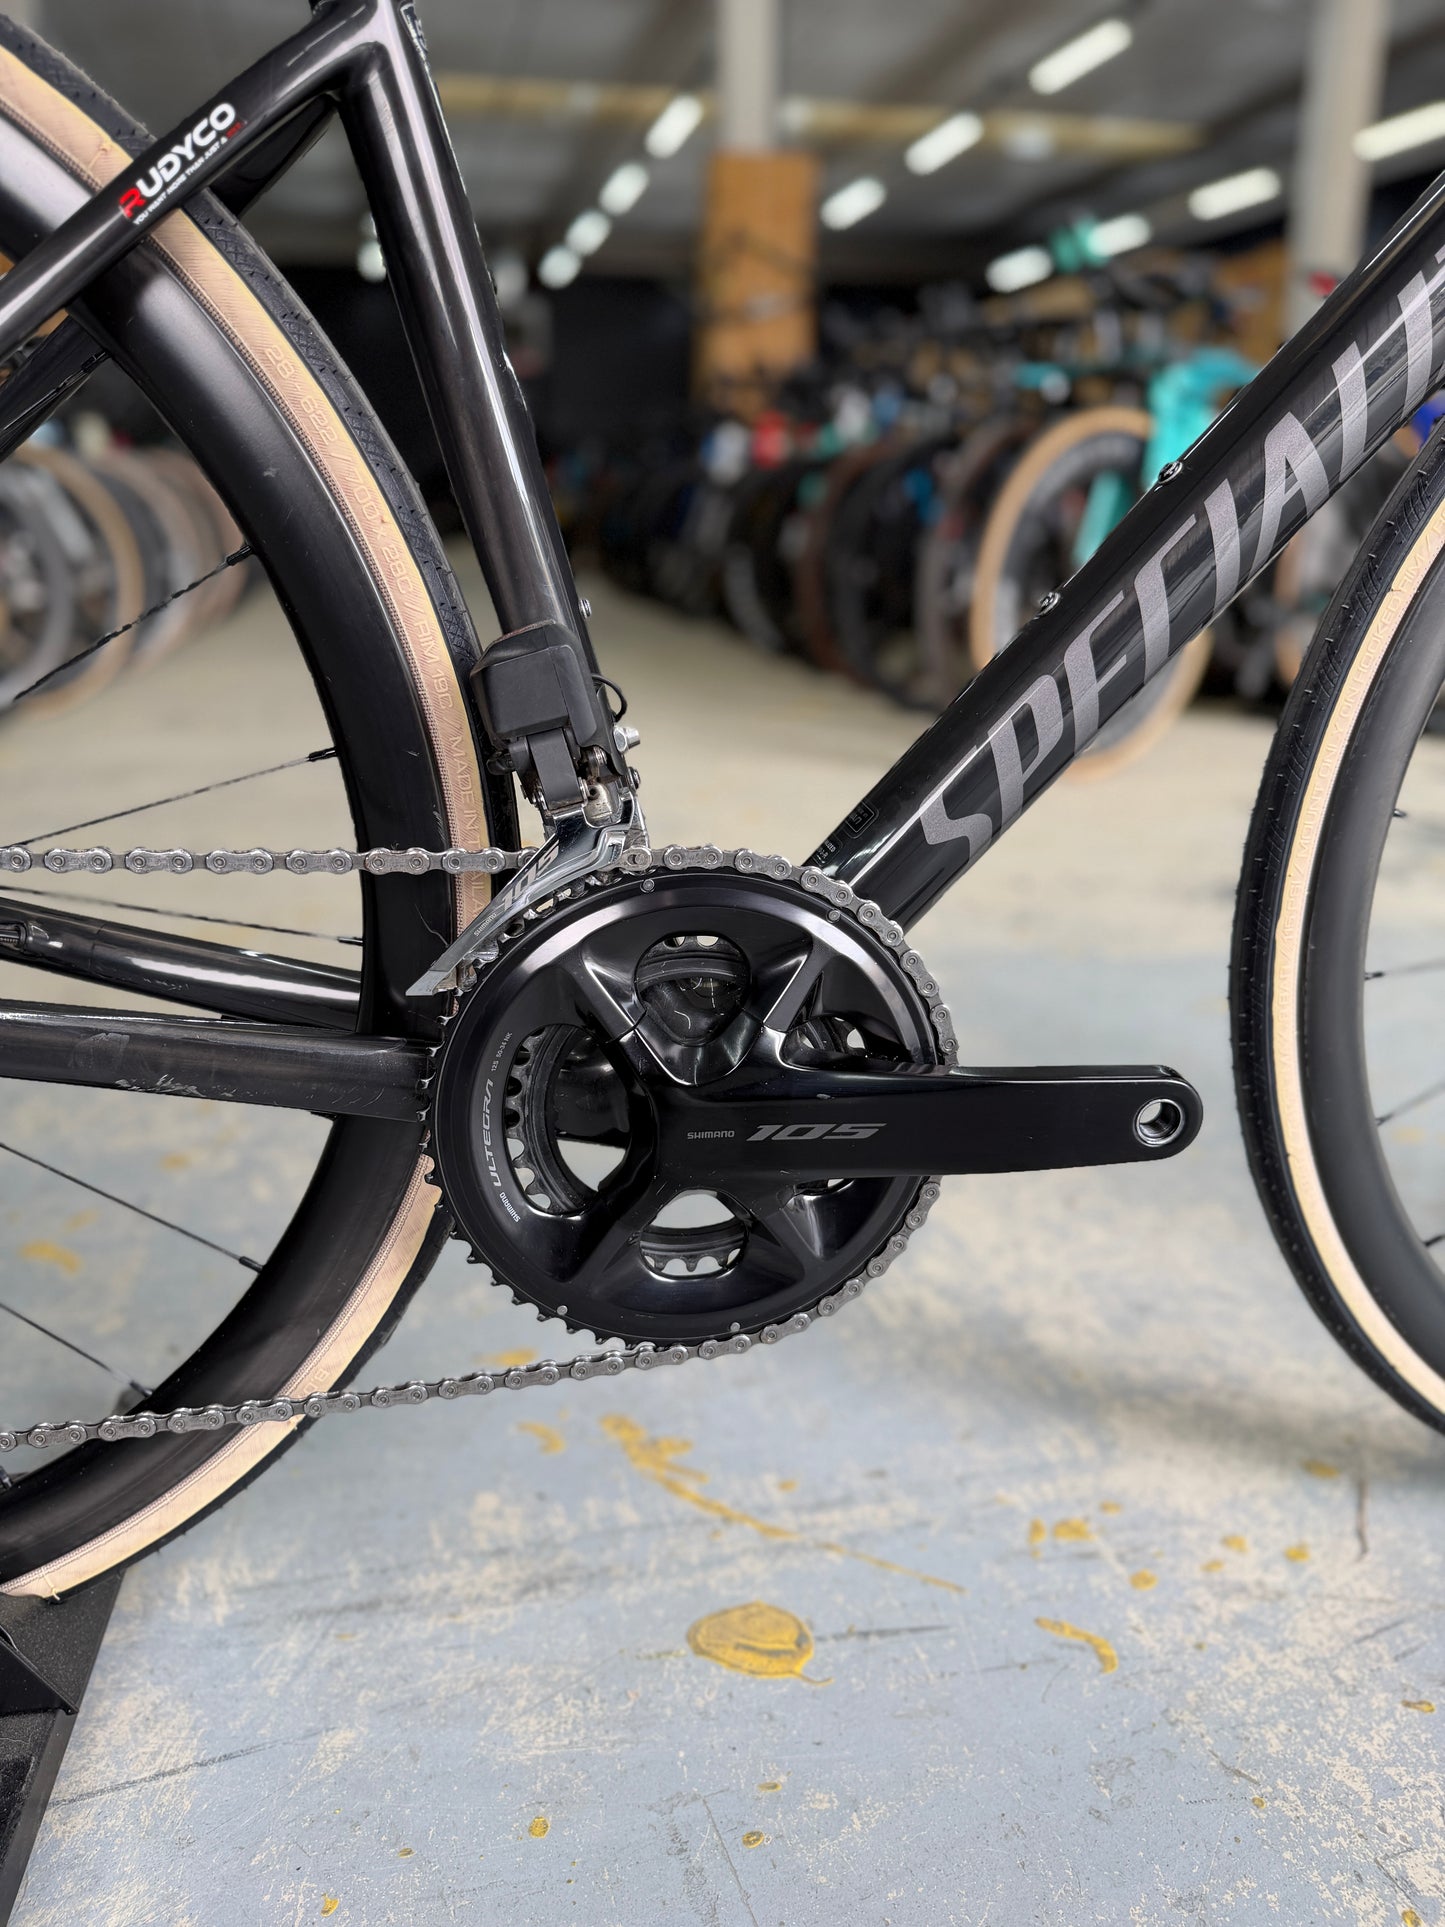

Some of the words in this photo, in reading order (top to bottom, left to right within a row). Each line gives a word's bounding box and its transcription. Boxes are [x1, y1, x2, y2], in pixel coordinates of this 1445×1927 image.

[119, 102, 236, 218] RUDYCO
[132, 211, 149, 225] YOU
[264, 345, 295, 379] 28
[301, 395, 338, 446] 622
[345, 469, 380, 521] 700
[382, 545, 413, 595] 28C
[414, 620, 440, 664] RIM
[432, 669, 453, 710] 19C
[450, 736, 475, 803] MADE
[464, 809, 479, 830] IN
[1294, 784, 1326, 858] MOUNT
[1317, 722, 1345, 779] ONLY
[1338, 684, 1360, 719] ON
[1351, 593, 1402, 684] HOOKED
[1397, 553, 1425, 593] RIM
[482, 1078, 502, 1187] ULTEGRA
[687, 1130, 735, 1140] SHIMANO
[746, 1122, 887, 1142] 105
[500, 1191, 521, 1223] SHIMANO
